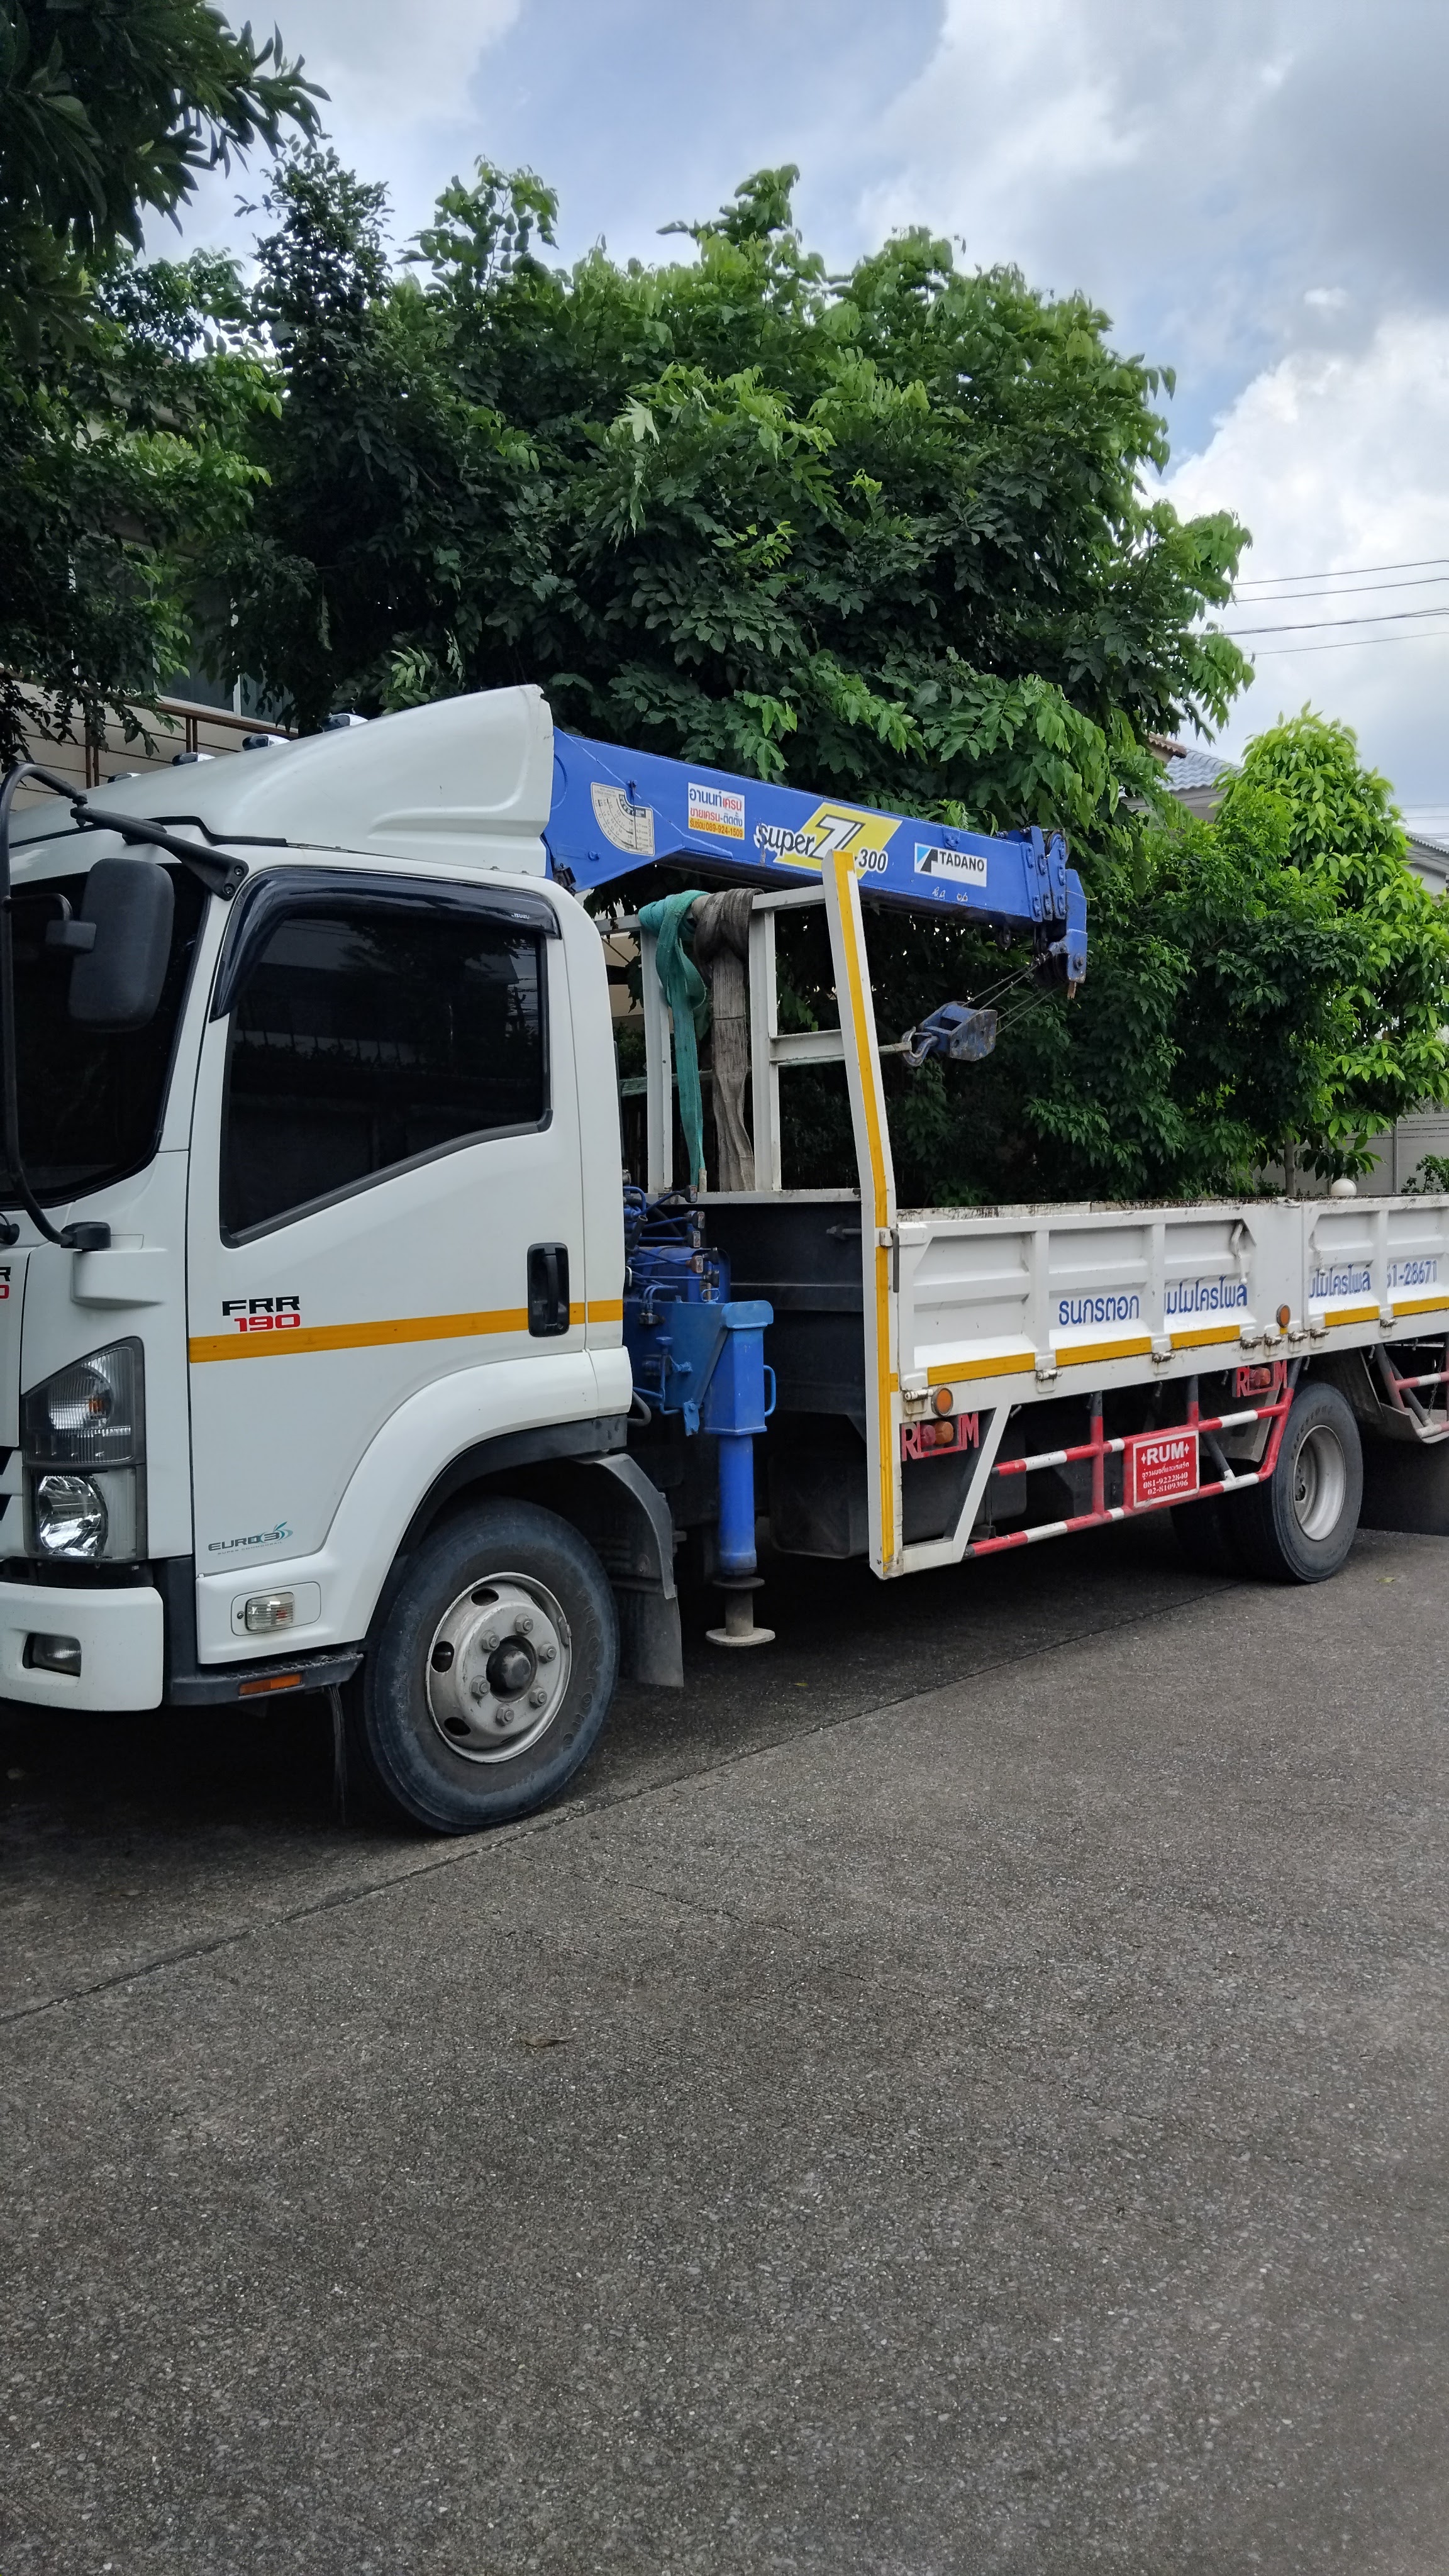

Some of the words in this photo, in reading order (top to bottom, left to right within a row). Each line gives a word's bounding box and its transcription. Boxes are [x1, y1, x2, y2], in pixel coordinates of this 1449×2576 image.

[706, 822, 743, 838] 089-924-1509
[858, 848, 886, 871] 300
[939, 850, 985, 872] TADANO
[222, 1296, 301, 1316] FRR
[1059, 1295, 1140, 1325] ธนกรตอก
[234, 1313, 301, 1332] 190
[1146, 1441, 1185, 1465] RUM
[1143, 1472, 1189, 1489] 081-9222840
[1147, 1479, 1189, 1496] 02-8109396
